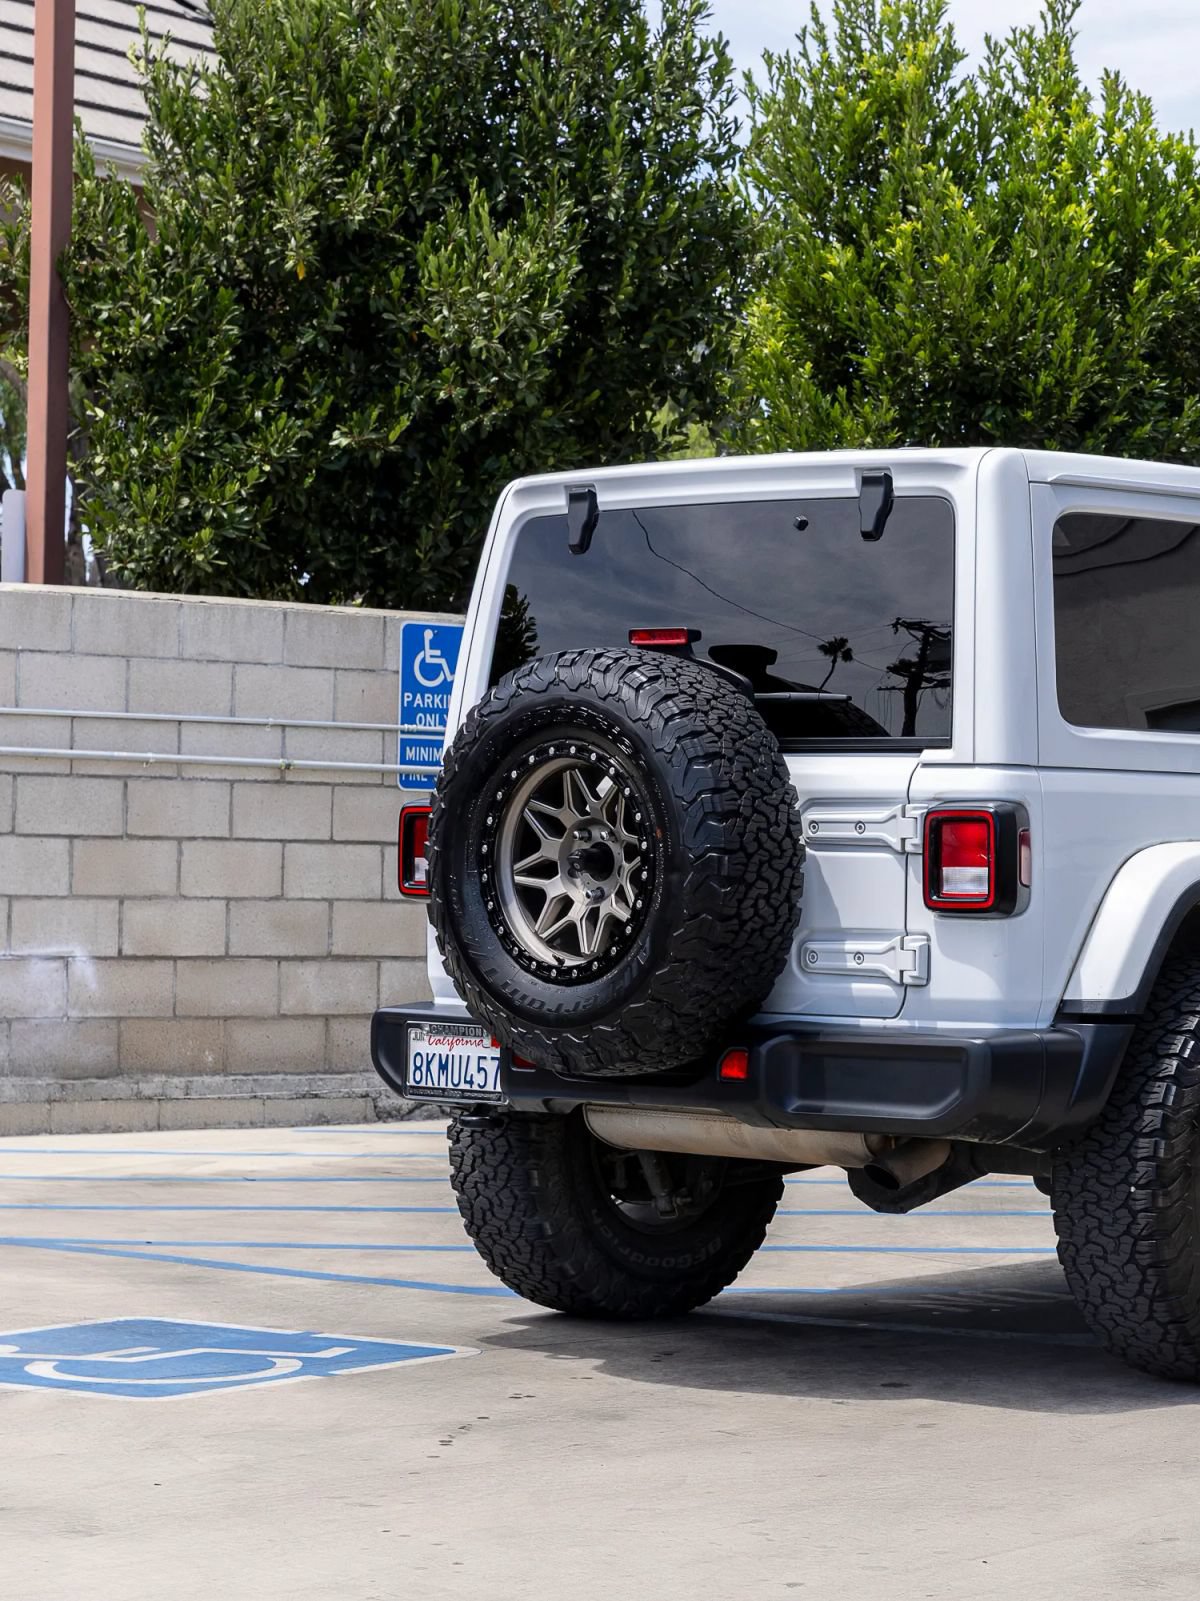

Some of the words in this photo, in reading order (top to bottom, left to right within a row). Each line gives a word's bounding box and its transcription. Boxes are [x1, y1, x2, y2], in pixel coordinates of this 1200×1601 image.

[403, 692, 452, 709] PARKI
[429, 1024, 483, 1037] CHAMPION
[427, 1034, 484, 1051] California
[412, 1051, 501, 1090] 8KMU457
